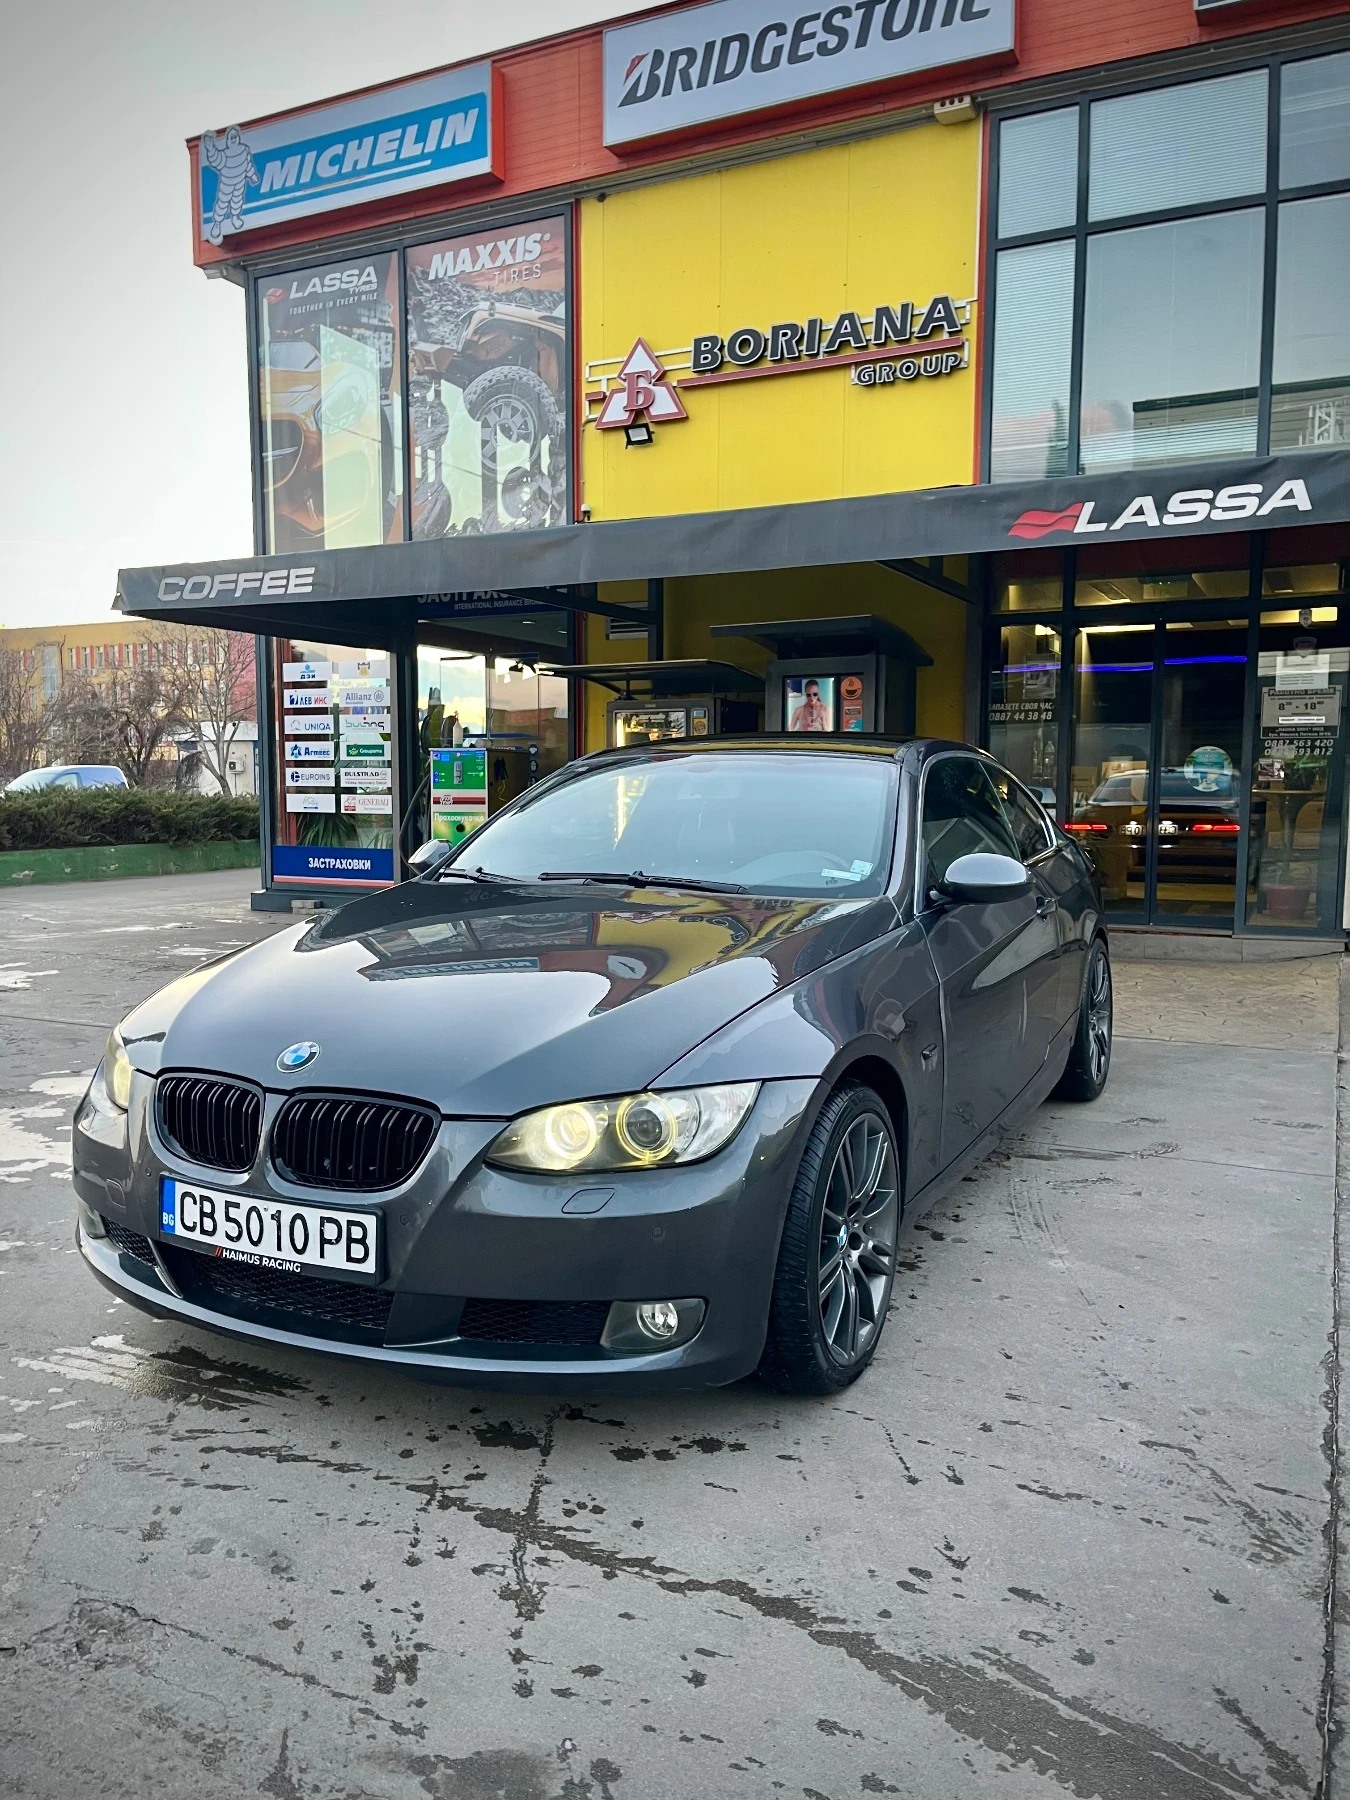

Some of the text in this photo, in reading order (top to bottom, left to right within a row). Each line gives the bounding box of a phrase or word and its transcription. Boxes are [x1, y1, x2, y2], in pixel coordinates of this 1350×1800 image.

[260, 107, 479, 193] MICHELIN
[493, 264, 542, 288] TIRES
[289, 266, 378, 300] LASSA
[349, 283, 378, 294] TYRES
[290, 292, 378, 316] TOGETHER IN EVERY MILE
[691, 295, 962, 374] BORIANA
[855, 352, 962, 386] GROUP
[1073, 479, 1313, 534] LASSA
[157, 567, 316, 600] COFFEE
[454, 601, 493, 610] INTERNATIONAL
[346, 692, 372, 701] Allianz
[1021, 702, 1038, 710] СВОЯ
[989, 711, 1053, 721] 0887 44 38 48
[304, 722, 331, 731] UNIQA
[1264, 739, 1334, 748] 0887 563 420
[1313, 748, 1333, 756] 812
[300, 773, 331, 781] EUROINS
[358, 798, 389, 806] GENERALI
[308, 857, 371, 870] ЗАСТРАХОВКИ
[162, 1211, 174, 1227] BG
[262, 1257, 301, 1272] RACING
